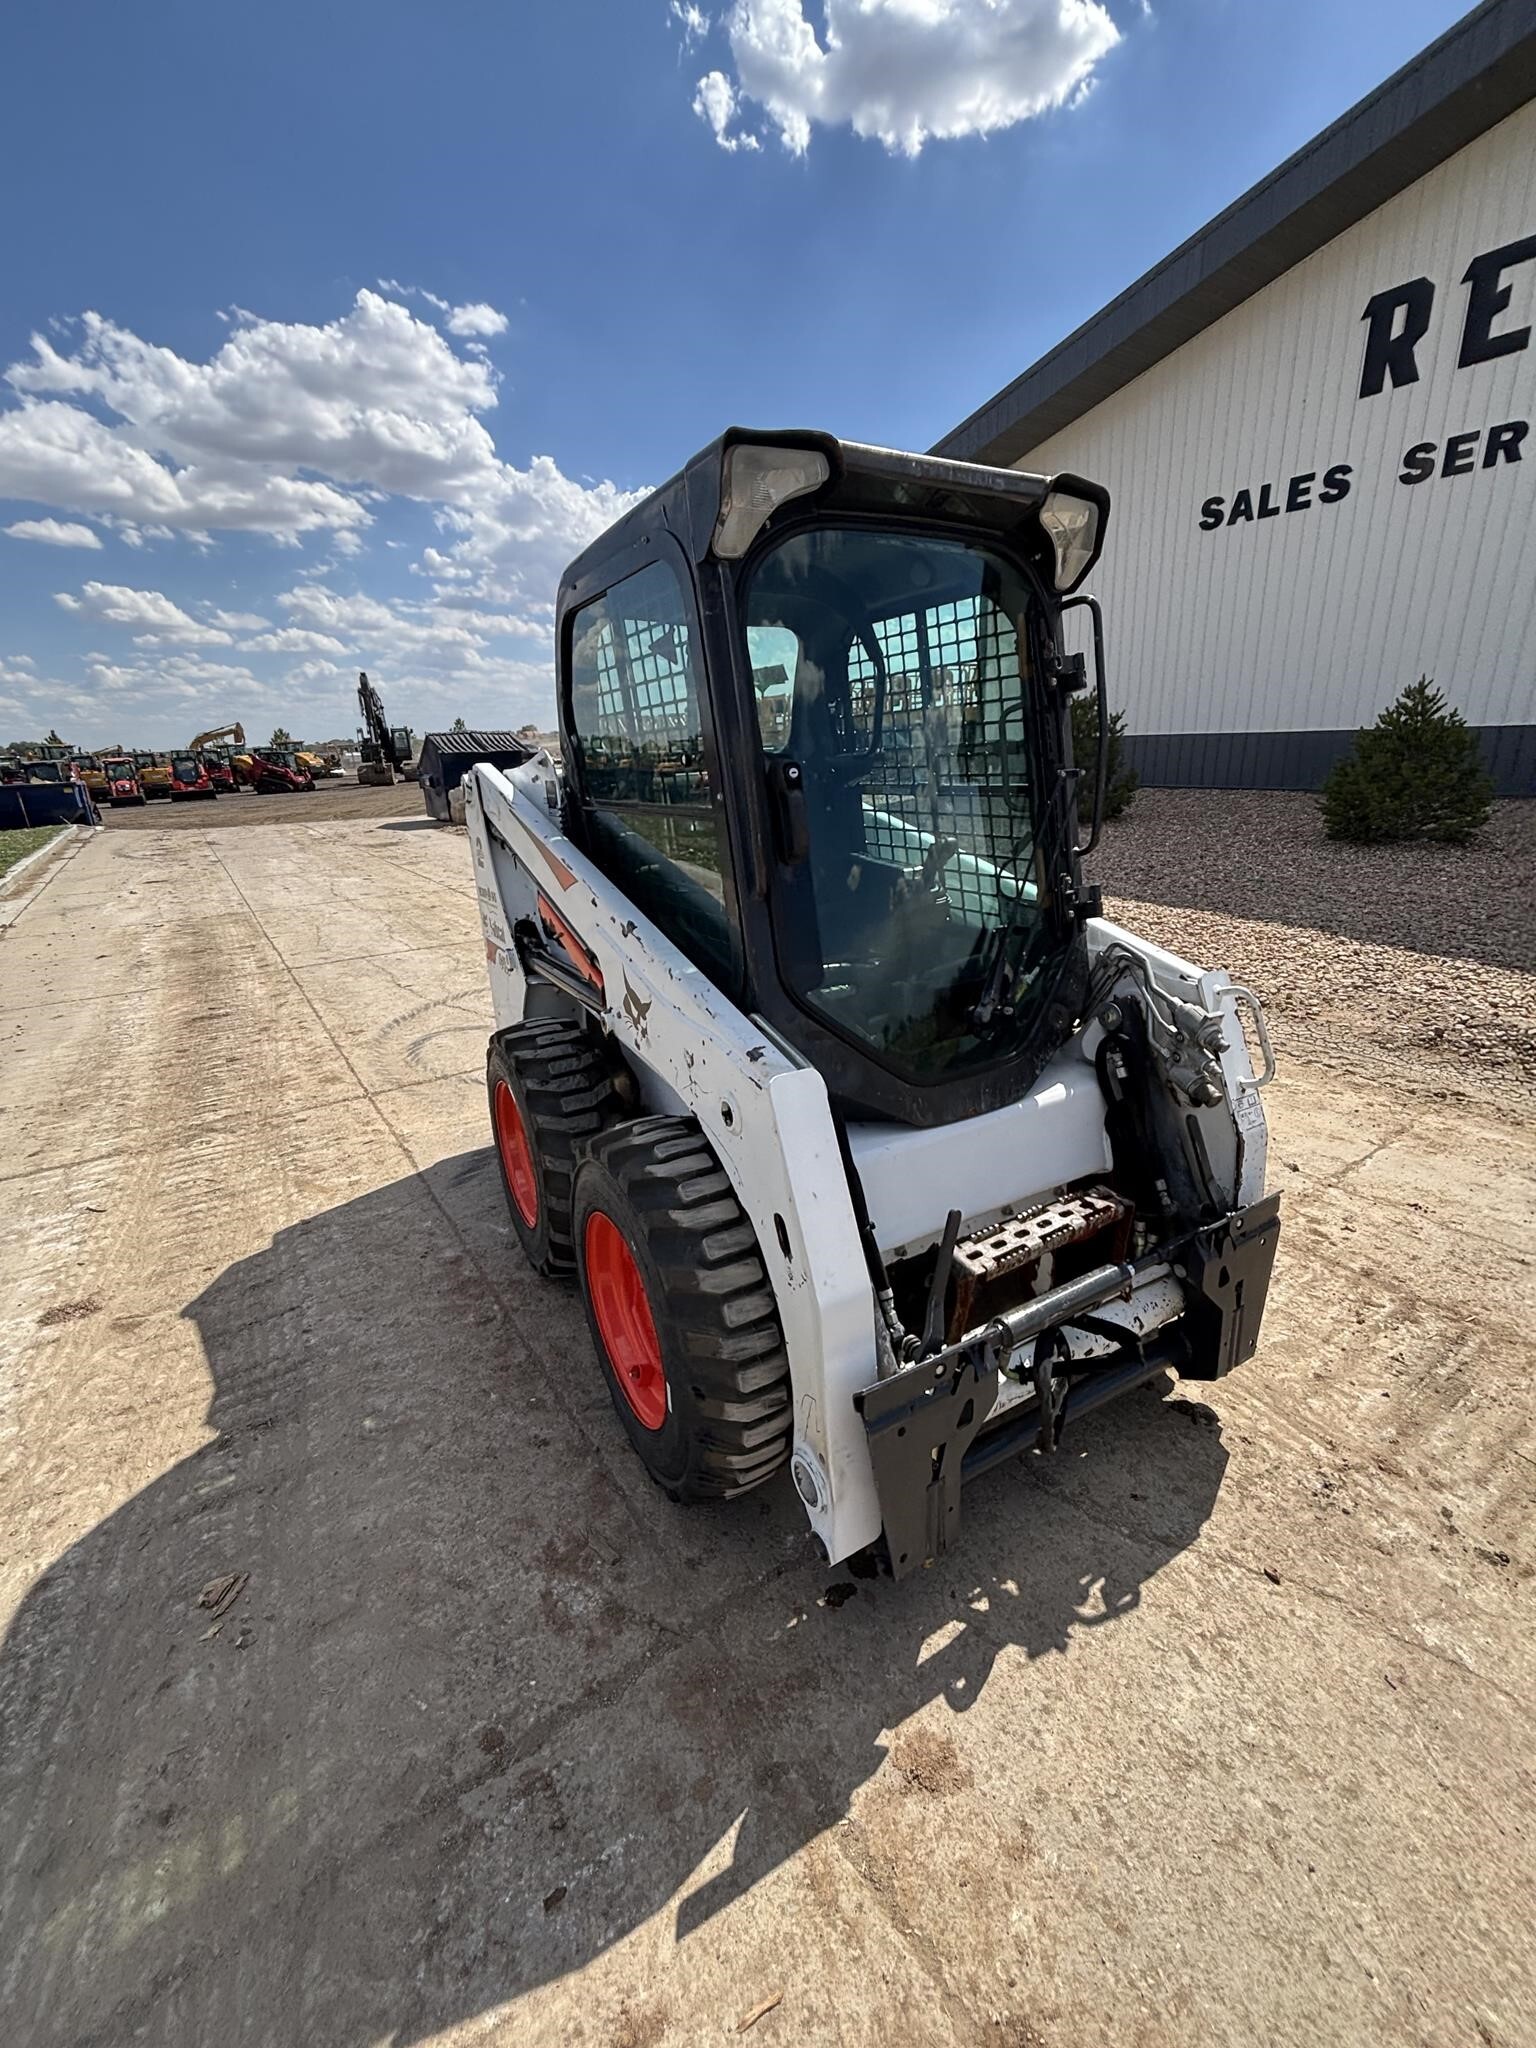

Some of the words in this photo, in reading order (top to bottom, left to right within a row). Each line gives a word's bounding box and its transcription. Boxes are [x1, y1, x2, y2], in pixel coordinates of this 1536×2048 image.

[1358, 234, 1536, 400] RE
[1198, 464, 1353, 531] SALES
[1398, 420, 1530, 486] SER
